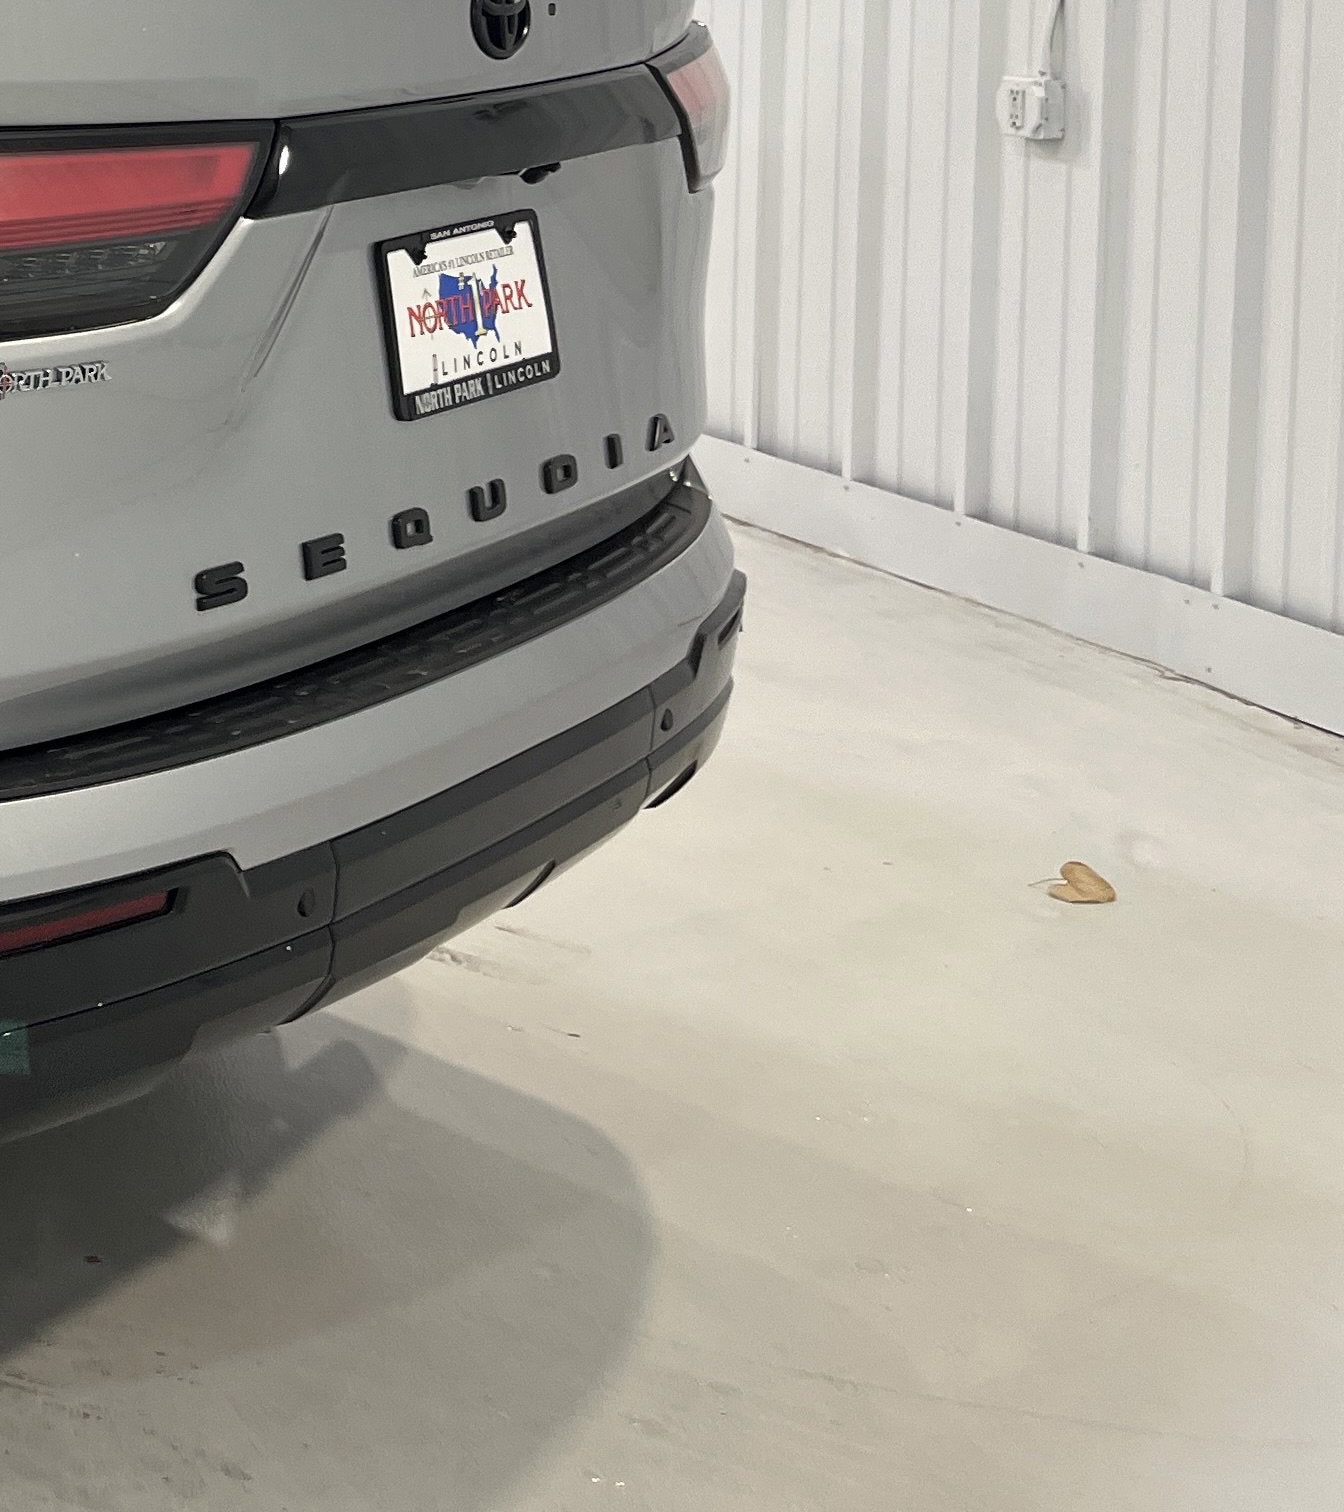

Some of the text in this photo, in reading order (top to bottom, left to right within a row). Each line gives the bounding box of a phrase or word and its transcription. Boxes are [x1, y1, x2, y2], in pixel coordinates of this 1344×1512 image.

[429, 220, 495, 240] SAN ANTONIO
[407, 279, 533, 338] NORTH PARK
[58, 361, 113, 386] PARK
[441, 340, 523, 376] LINCOLN
[414, 359, 551, 415] NORTH PARK LINCOLN
[193, 413, 676, 612] SEQUOIA
